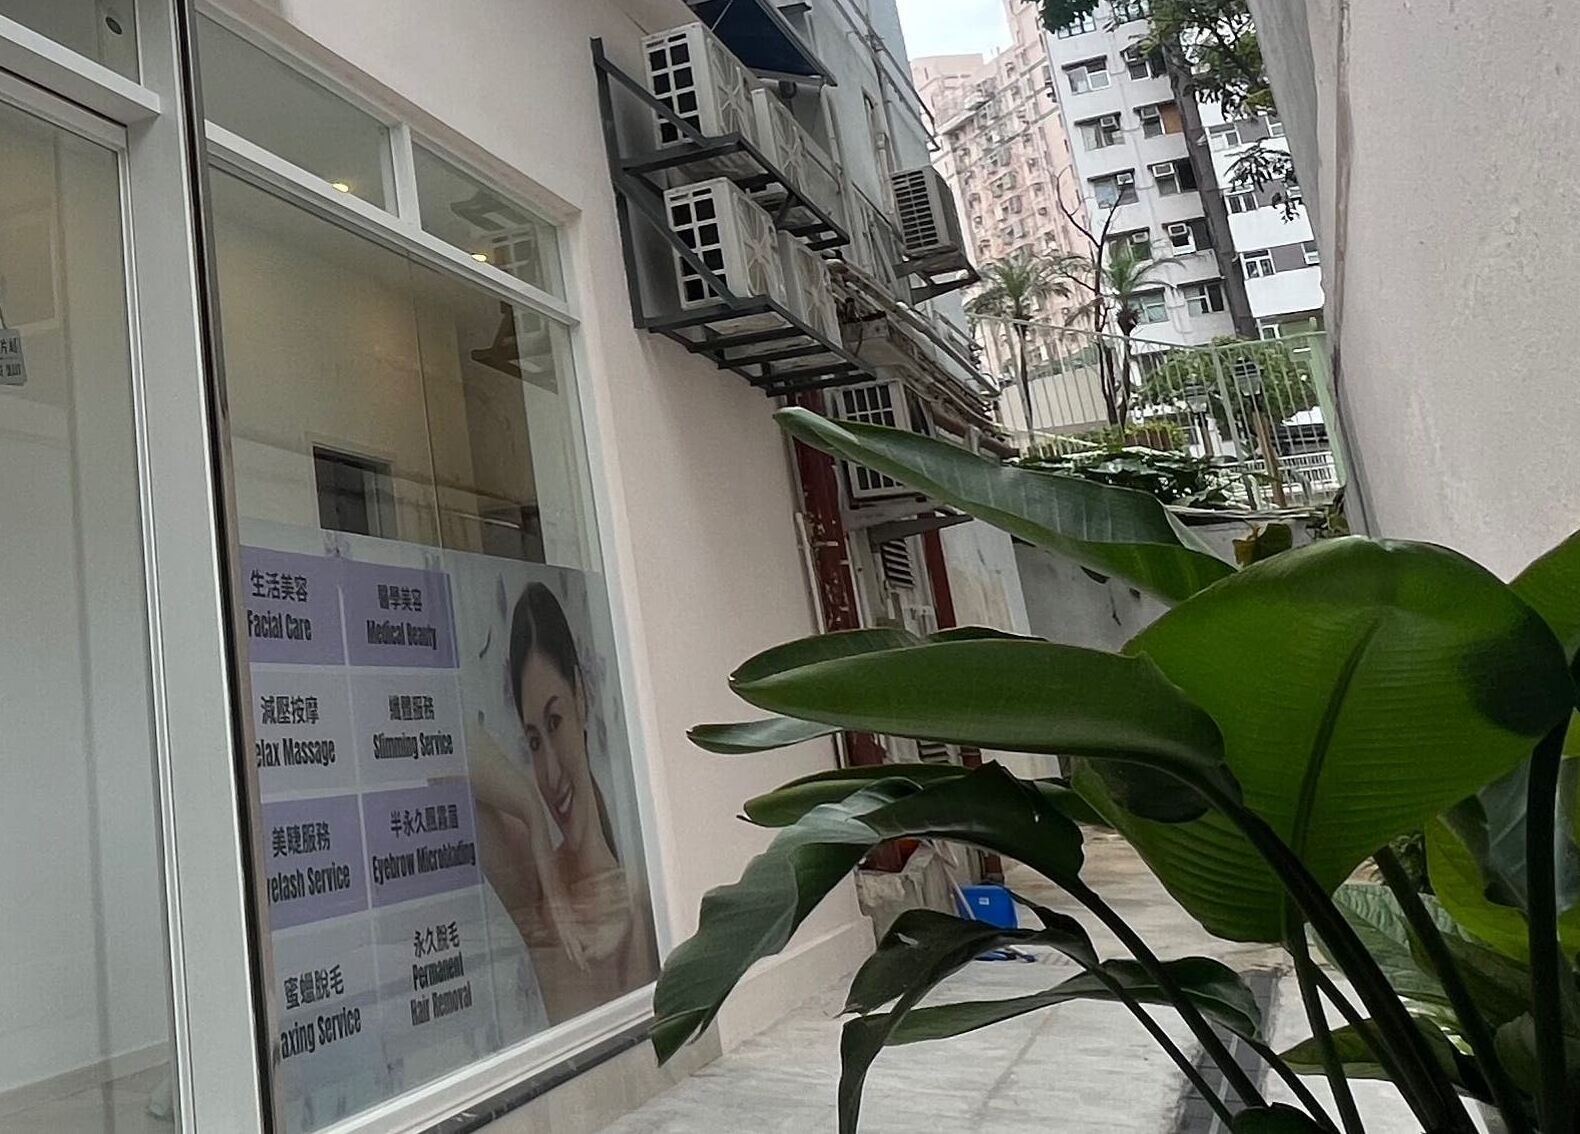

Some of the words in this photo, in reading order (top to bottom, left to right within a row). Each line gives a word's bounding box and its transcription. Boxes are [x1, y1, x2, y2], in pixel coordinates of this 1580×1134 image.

[250, 568, 309, 603] 生活美容
[247, 609, 284, 640] Facial
[285, 613, 312, 641] Care
[260, 695, 320, 725] 減壓按摩
[255, 738, 281, 768] elax
[282, 737, 336, 766] Massage
[372, 731, 419, 760] Slimming
[419, 730, 454, 757] Service
[272, 821, 331, 858] 美睫服務
[267, 869, 306, 905] elash
[307, 861, 351, 896] Service
[372, 851, 415, 886] Eyebrow
[413, 921, 461, 958] 永久脫毛
[283, 964, 345, 1010] 蜜蠟脫毛
[411, 951, 465, 992] Permanent
[431, 981, 473, 1019] Removal
[280, 1022, 316, 1060] axing
[316, 1006, 362, 1046] Service
